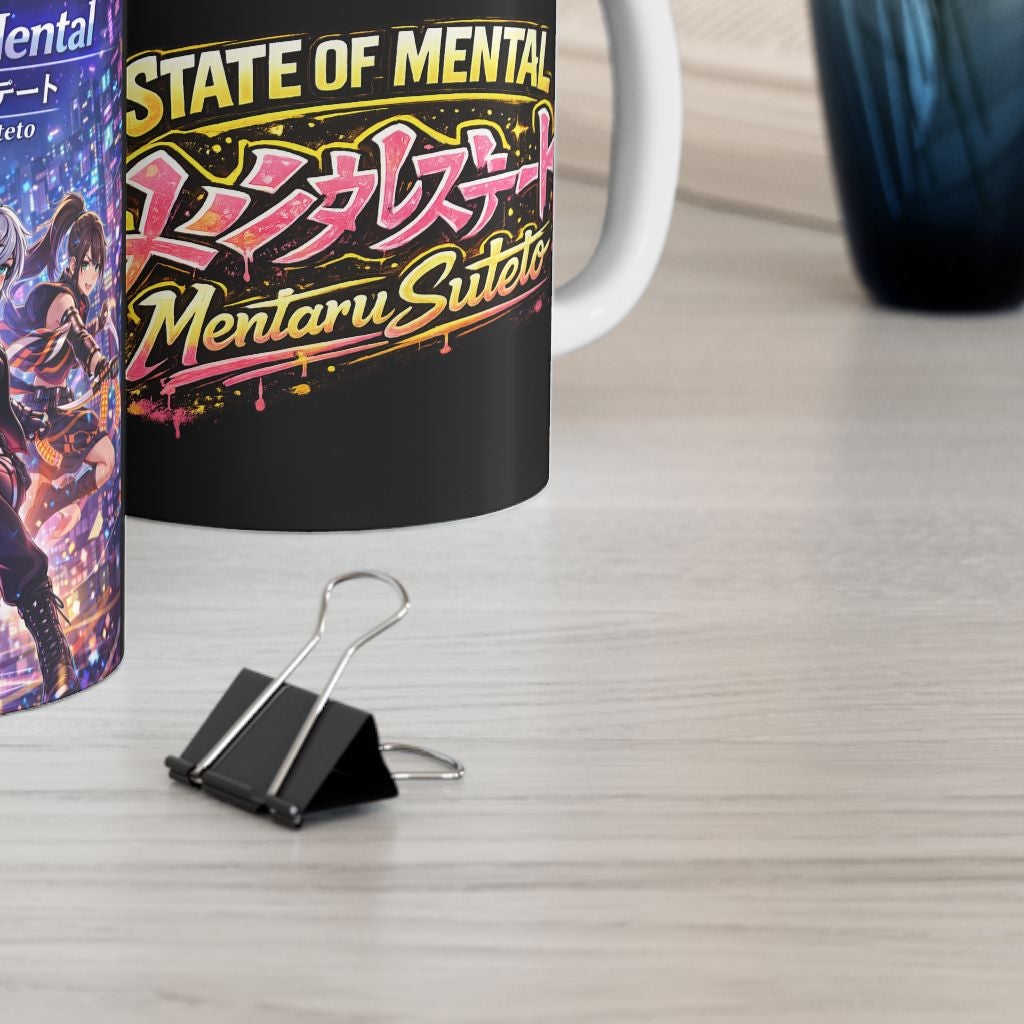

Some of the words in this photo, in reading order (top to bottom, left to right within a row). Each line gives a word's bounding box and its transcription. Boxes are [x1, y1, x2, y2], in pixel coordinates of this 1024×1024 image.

[126, 38, 302, 138] STATE
[314, 35, 380, 92] OF
[393, 25, 551, 94] MENTAL
[126, 282, 395, 382] Mentaru
[384, 226, 552, 340] Suteto
